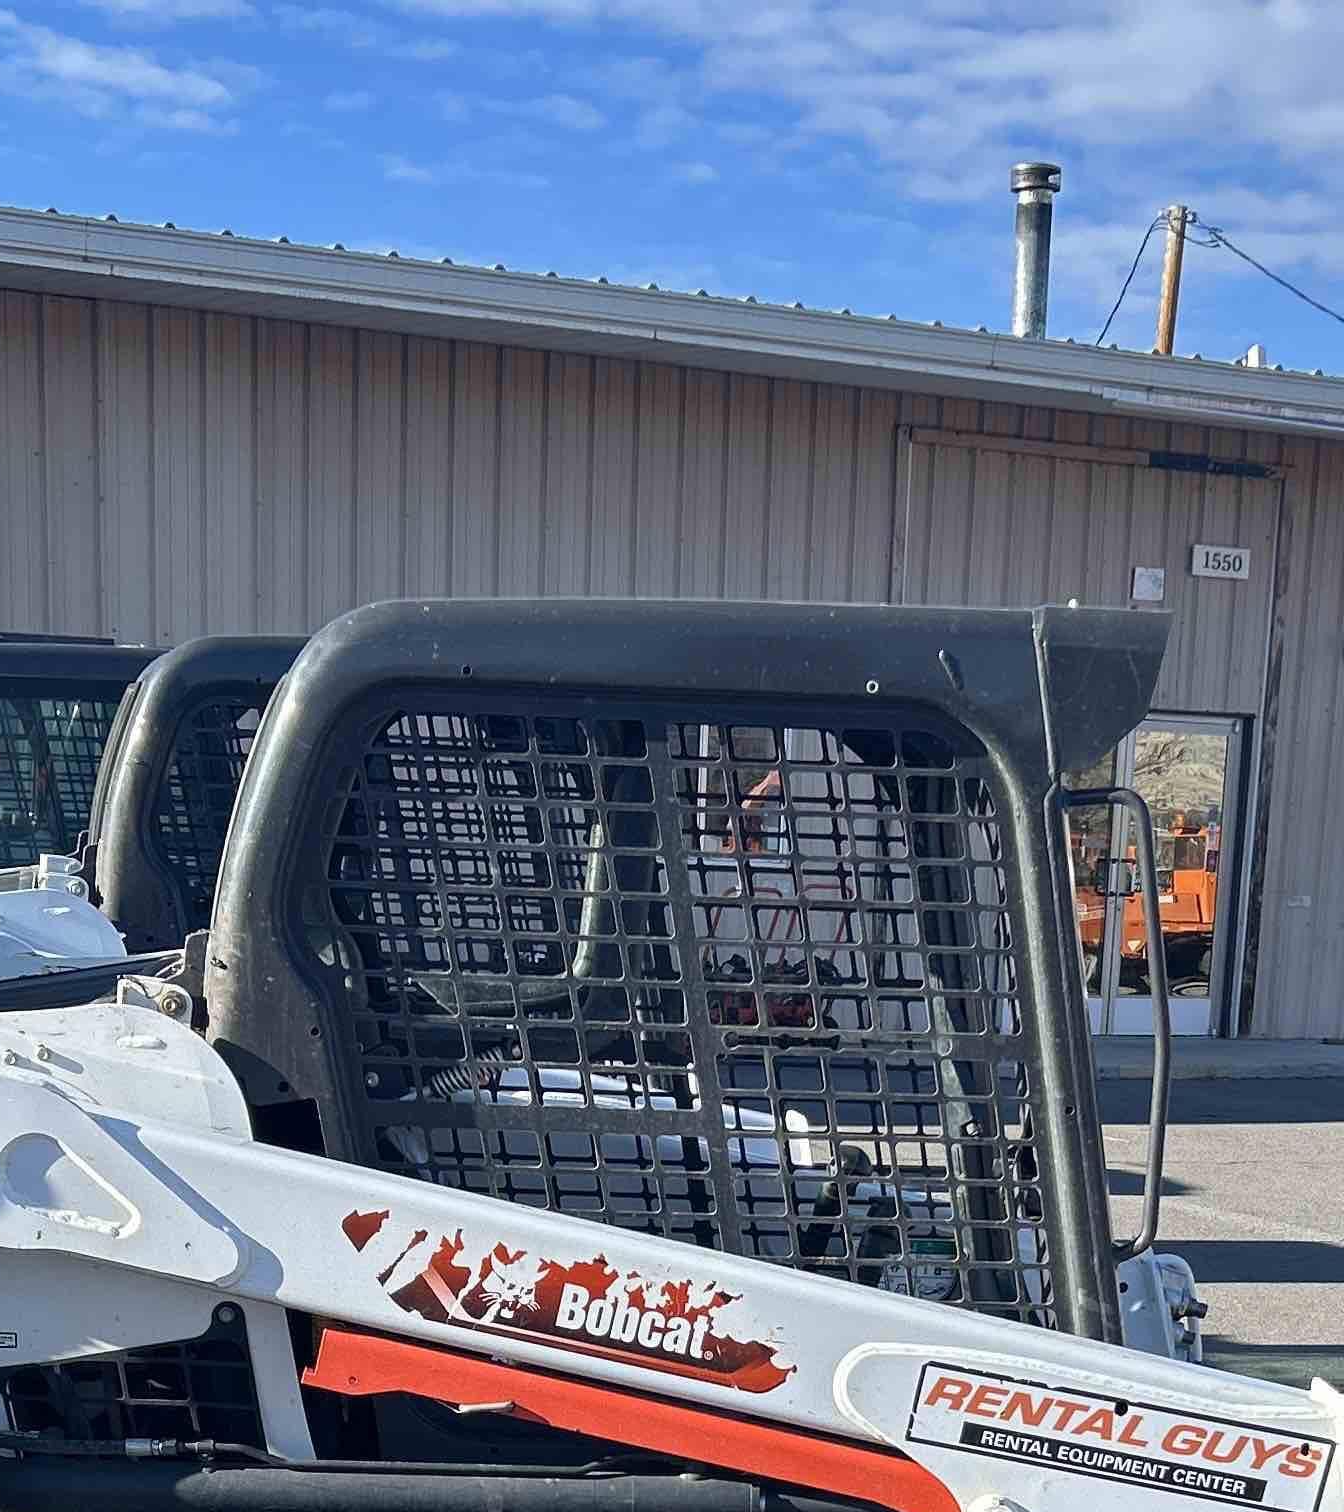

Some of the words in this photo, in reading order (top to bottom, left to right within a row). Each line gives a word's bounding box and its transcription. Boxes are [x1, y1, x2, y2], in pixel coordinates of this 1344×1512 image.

[1202, 550, 1243, 573] 1550
[555, 1282, 710, 1360] Bobcat
[923, 1375, 1149, 1448] RENTAL
[1161, 1423, 1324, 1479] GUYS
[980, 1429, 1054, 1459] RENTAL
[1056, 1445, 1169, 1480] EQUIPMENT
[1172, 1468, 1247, 1496] CENTER
